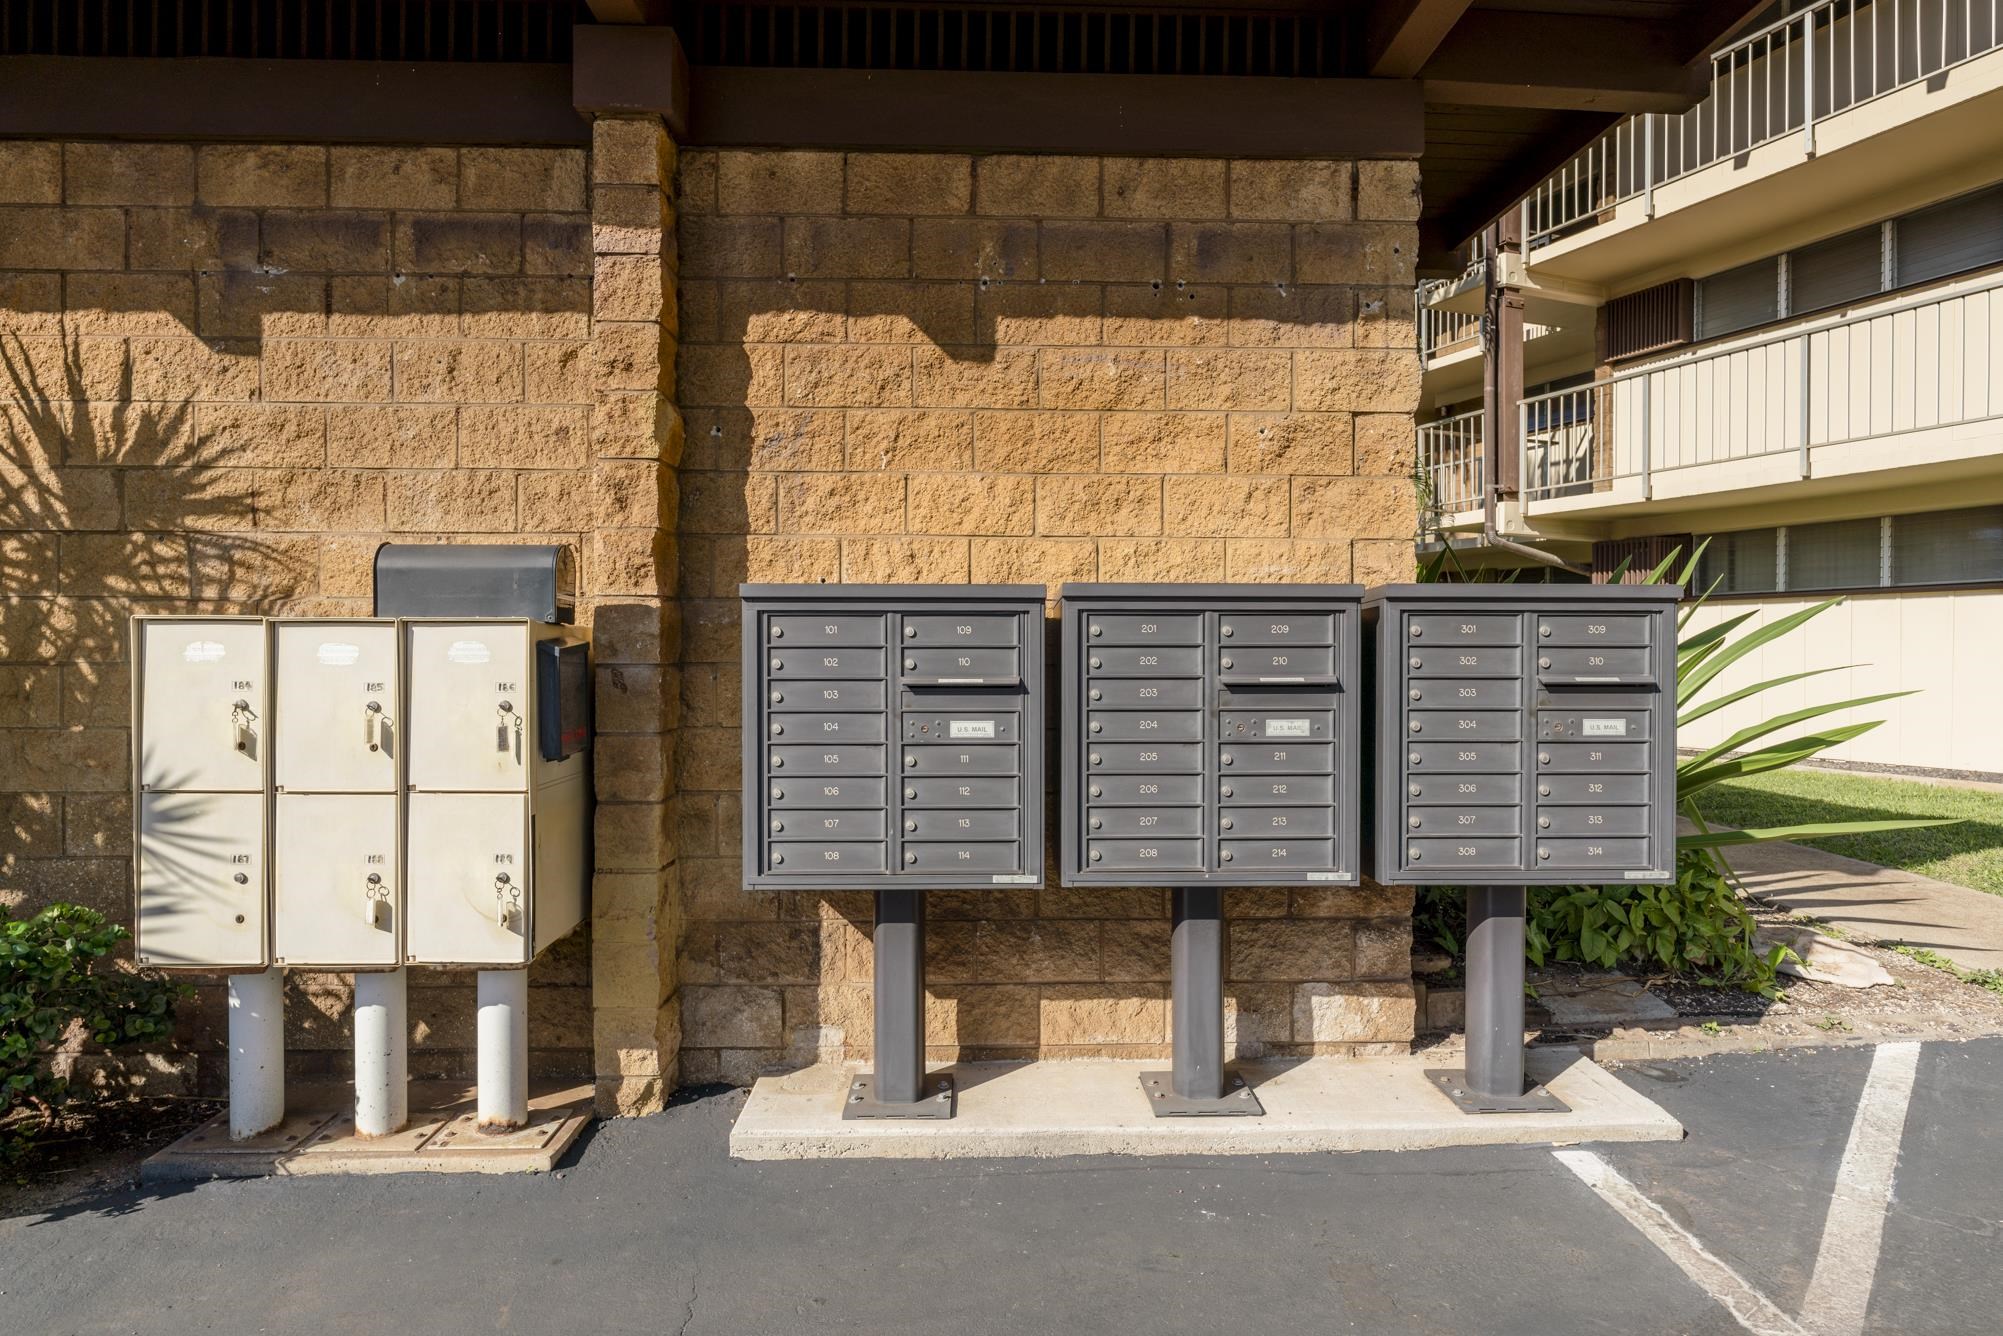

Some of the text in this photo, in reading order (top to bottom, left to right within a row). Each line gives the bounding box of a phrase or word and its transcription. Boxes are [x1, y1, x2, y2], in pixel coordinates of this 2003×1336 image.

[825, 625, 838, 635] 101
[956, 625, 972, 635] 109
[1141, 624, 1157, 633] 201
[1271, 624, 1290, 634] 209
[1461, 624, 1477, 634] 301
[1588, 625, 1606, 634] 309
[823, 657, 839, 667] 102
[958, 657, 971, 667] 110
[1139, 656, 1158, 665] 202
[1272, 656, 1288, 666] 210
[1459, 656, 1477, 665] 302
[1588, 656, 1604, 666] 310
[367, 682, 384, 692] 185
[823, 690, 839, 699] 103
[1139, 688, 1158, 697] 203
[1458, 688, 1477, 697] 303
[823, 722, 839, 731] 104
[1139, 720, 1158, 729] 204
[1458, 720, 1476, 729] 304
[823, 754, 839, 764] 105
[960, 754, 969, 763] 111
[1139, 752, 1158, 761] 205
[1274, 751, 1286, 761] 211
[1458, 751, 1477, 761] 305
[1590, 751, 1602, 761] 311
[823, 786, 839, 796] 106
[959, 786, 971, 796] 112
[1139, 784, 1158, 794] 206
[1272, 784, 1287, 794] 212
[1458, 783, 1477, 793] 306
[1588, 783, 1603, 793] 312
[824, 819, 839, 828] 107
[958, 818, 970, 828] 113
[1139, 816, 1158, 826] 207
[1272, 816, 1287, 826] 213
[1458, 815, 1476, 825] 307
[1588, 815, 1603, 825] 313
[824, 851, 840, 861] 108
[958, 850, 970, 860] 114
[1139, 848, 1158, 858] 208
[1271, 848, 1287, 858] 214
[1458, 846, 1476, 856] 308
[1587, 846, 1603, 856] 314
